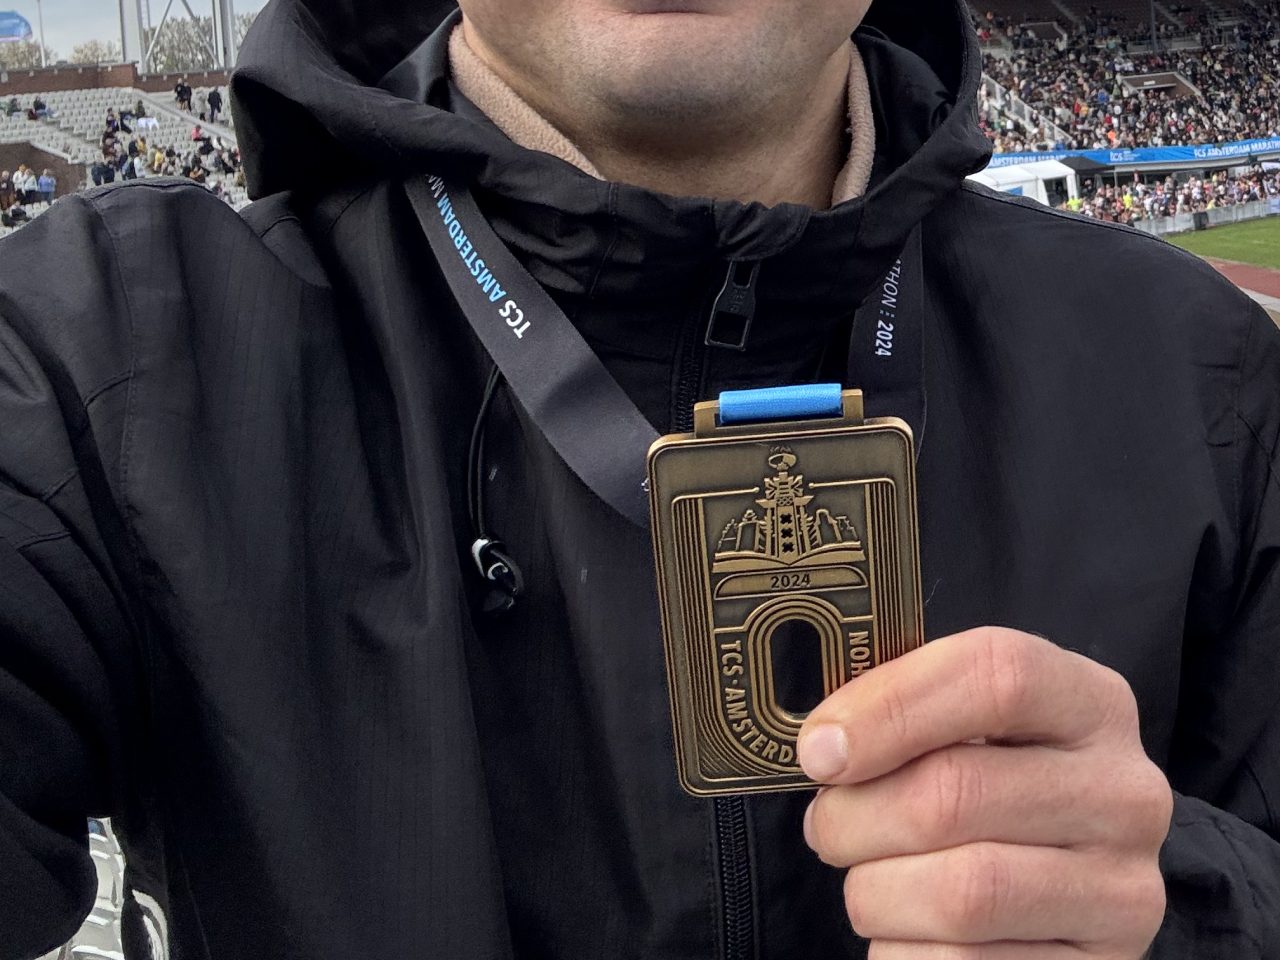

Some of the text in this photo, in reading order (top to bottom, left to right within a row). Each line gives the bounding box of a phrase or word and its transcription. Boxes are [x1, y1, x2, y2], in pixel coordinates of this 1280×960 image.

[1207, 144, 1250, 157] AMSTERDAM
[437, 193, 507, 303] AMSTERDAM
[498, 299, 531, 339] TCS
[875, 320, 894, 356] 2024
[770, 573, 811, 589] 2024
[720, 640, 800, 765] TCS AMSTERD
